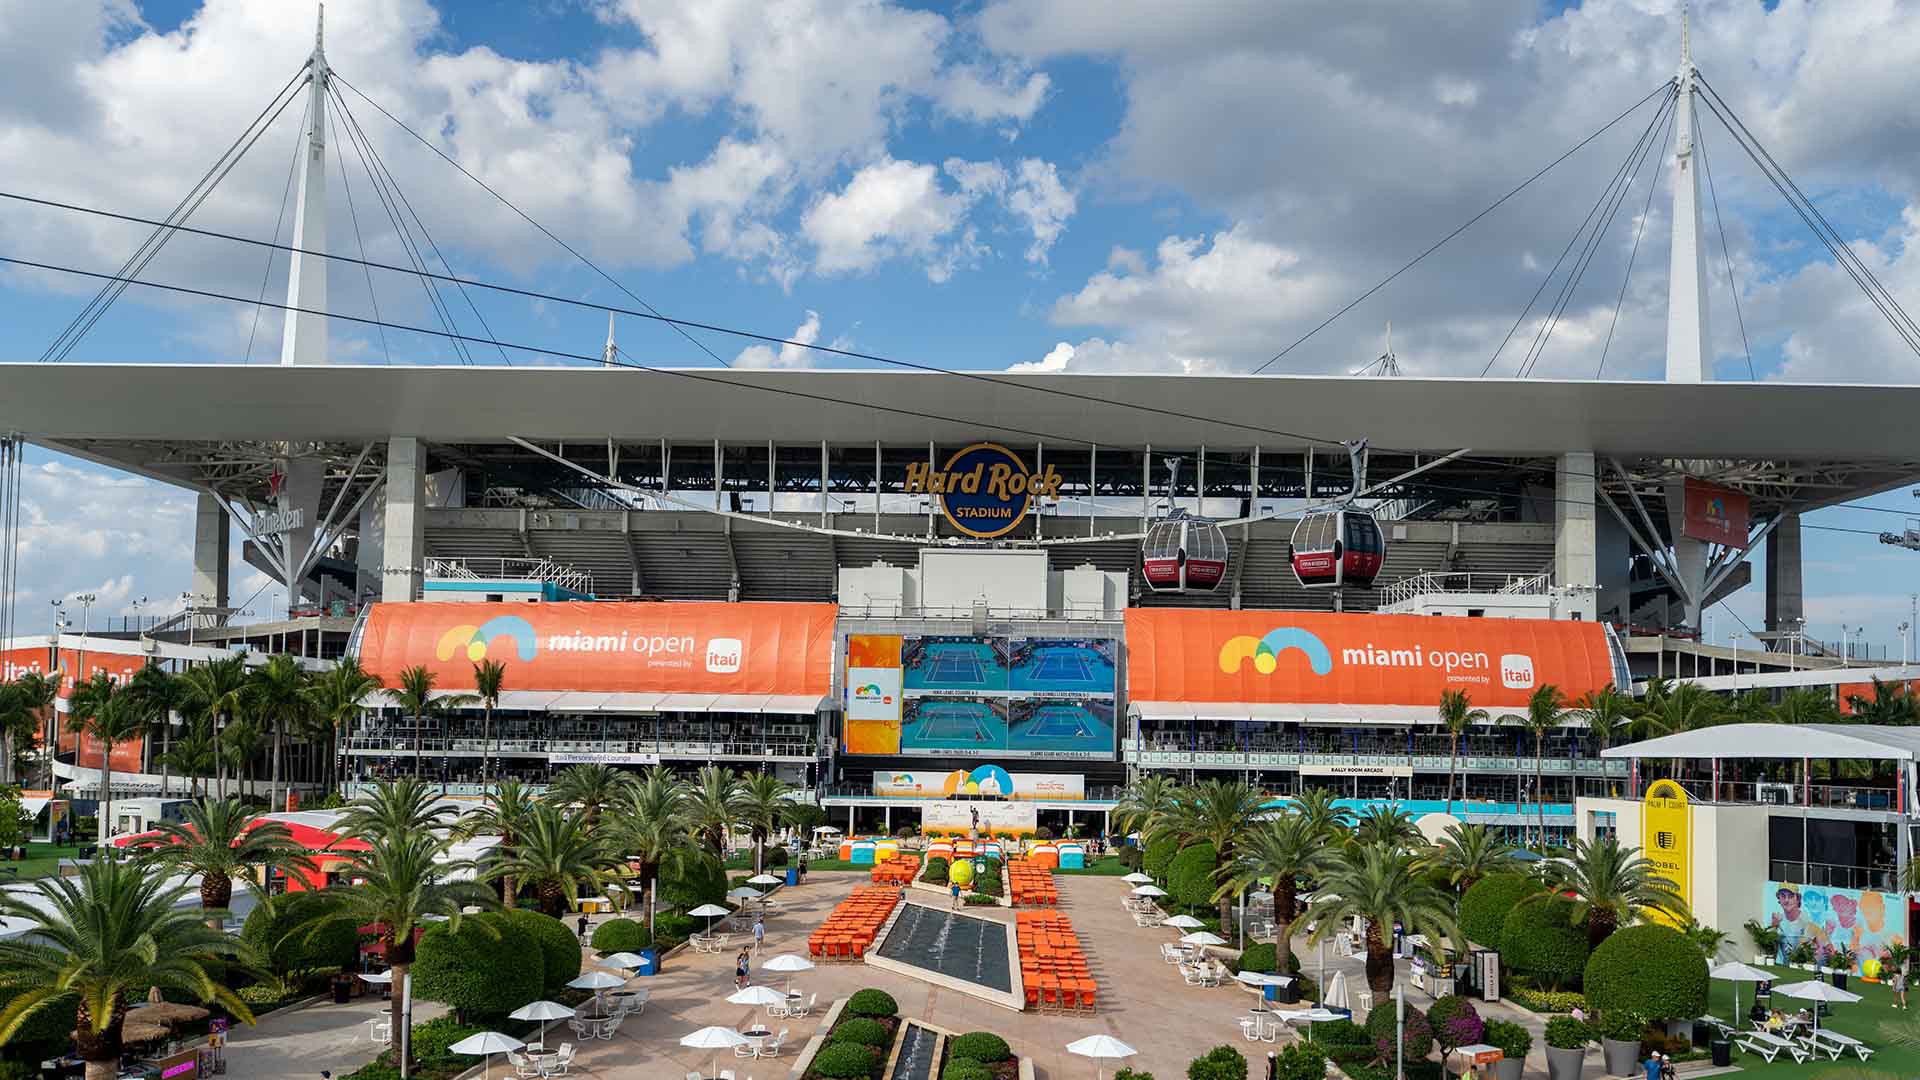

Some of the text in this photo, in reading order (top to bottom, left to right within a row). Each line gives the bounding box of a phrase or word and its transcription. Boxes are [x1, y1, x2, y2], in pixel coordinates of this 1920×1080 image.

[904, 462, 1064, 501] Hard Rock
[250, 508, 304, 537] Heineken
[956, 506, 1012, 518] STADIUM
[548, 630, 695, 658] miami open
[1342, 643, 1489, 672] miami open
